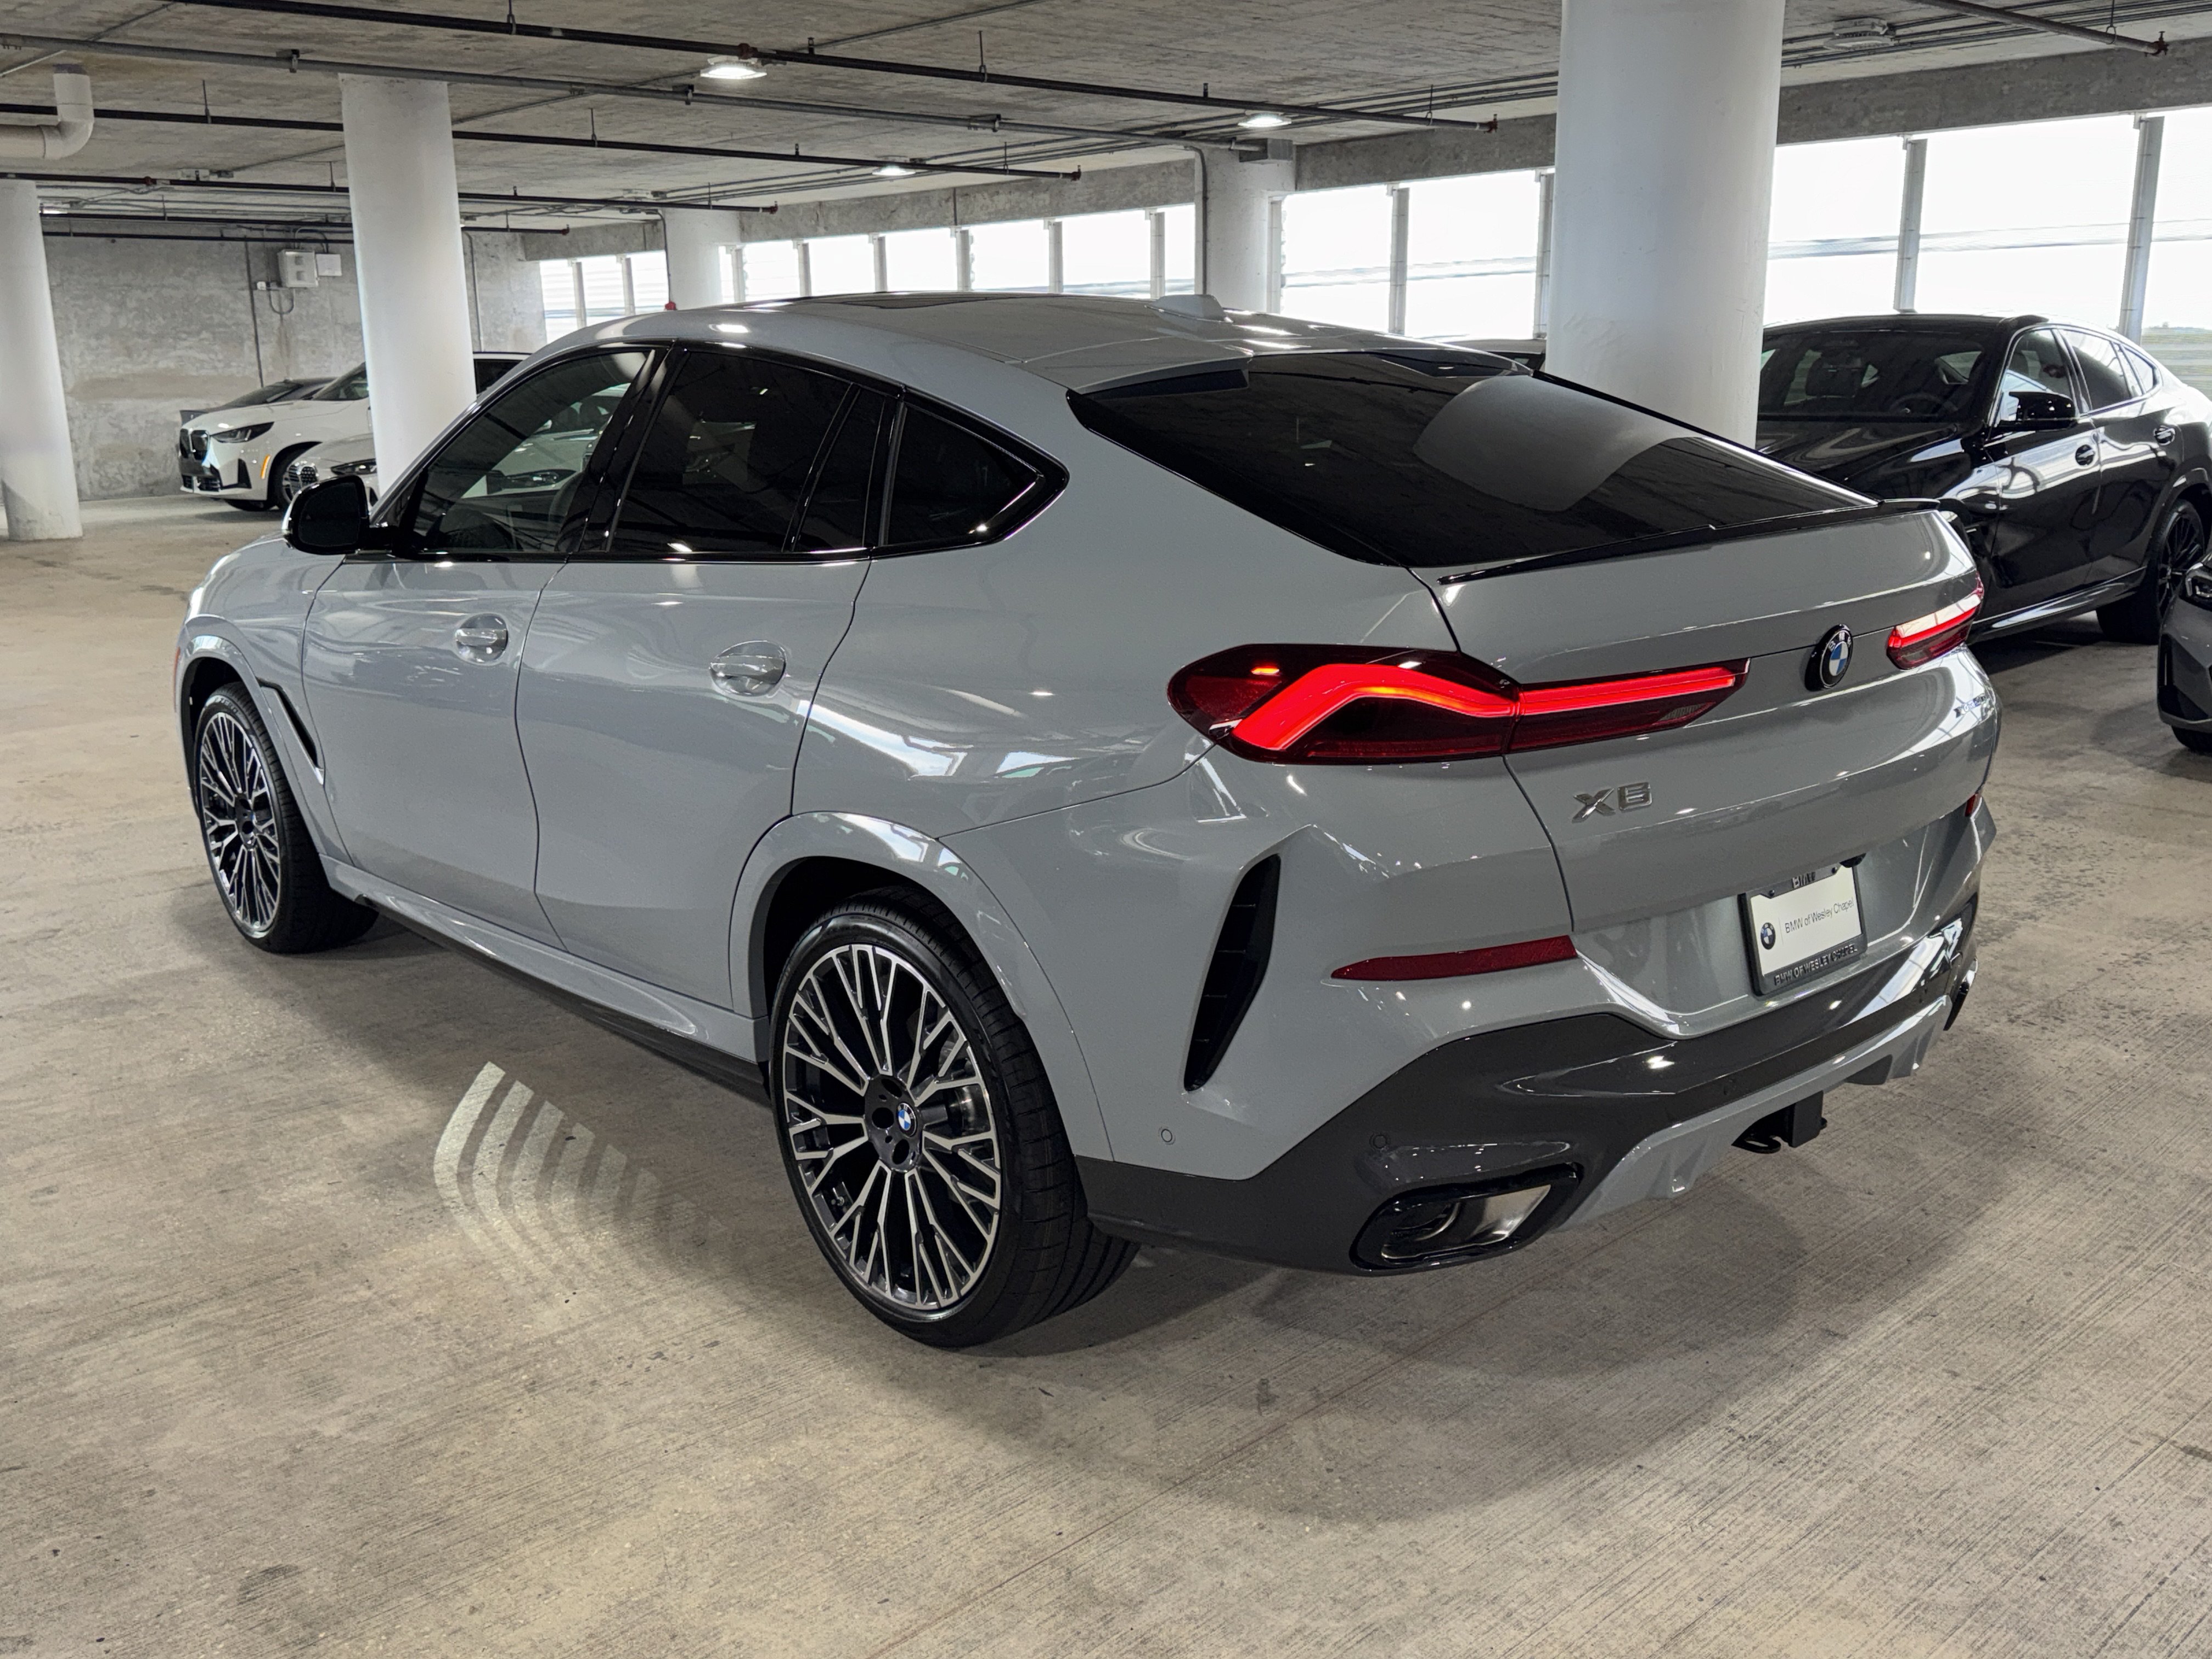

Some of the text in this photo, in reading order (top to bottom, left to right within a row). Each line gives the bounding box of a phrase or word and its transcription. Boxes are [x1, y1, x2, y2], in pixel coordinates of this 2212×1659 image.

[1828, 631, 1852, 651] BMW
[1572, 782, 1652, 823] X6
[1785, 917, 1803, 933] BMW
[1804, 915, 1811, 926] of
[1811, 908, 1833, 923] Wesley
[1833, 898, 1854, 913] Chapel
[1775, 969, 1792, 985] BMW
[1794, 965, 1804, 978] OF
[1803, 955, 1831, 973] WESLEY
